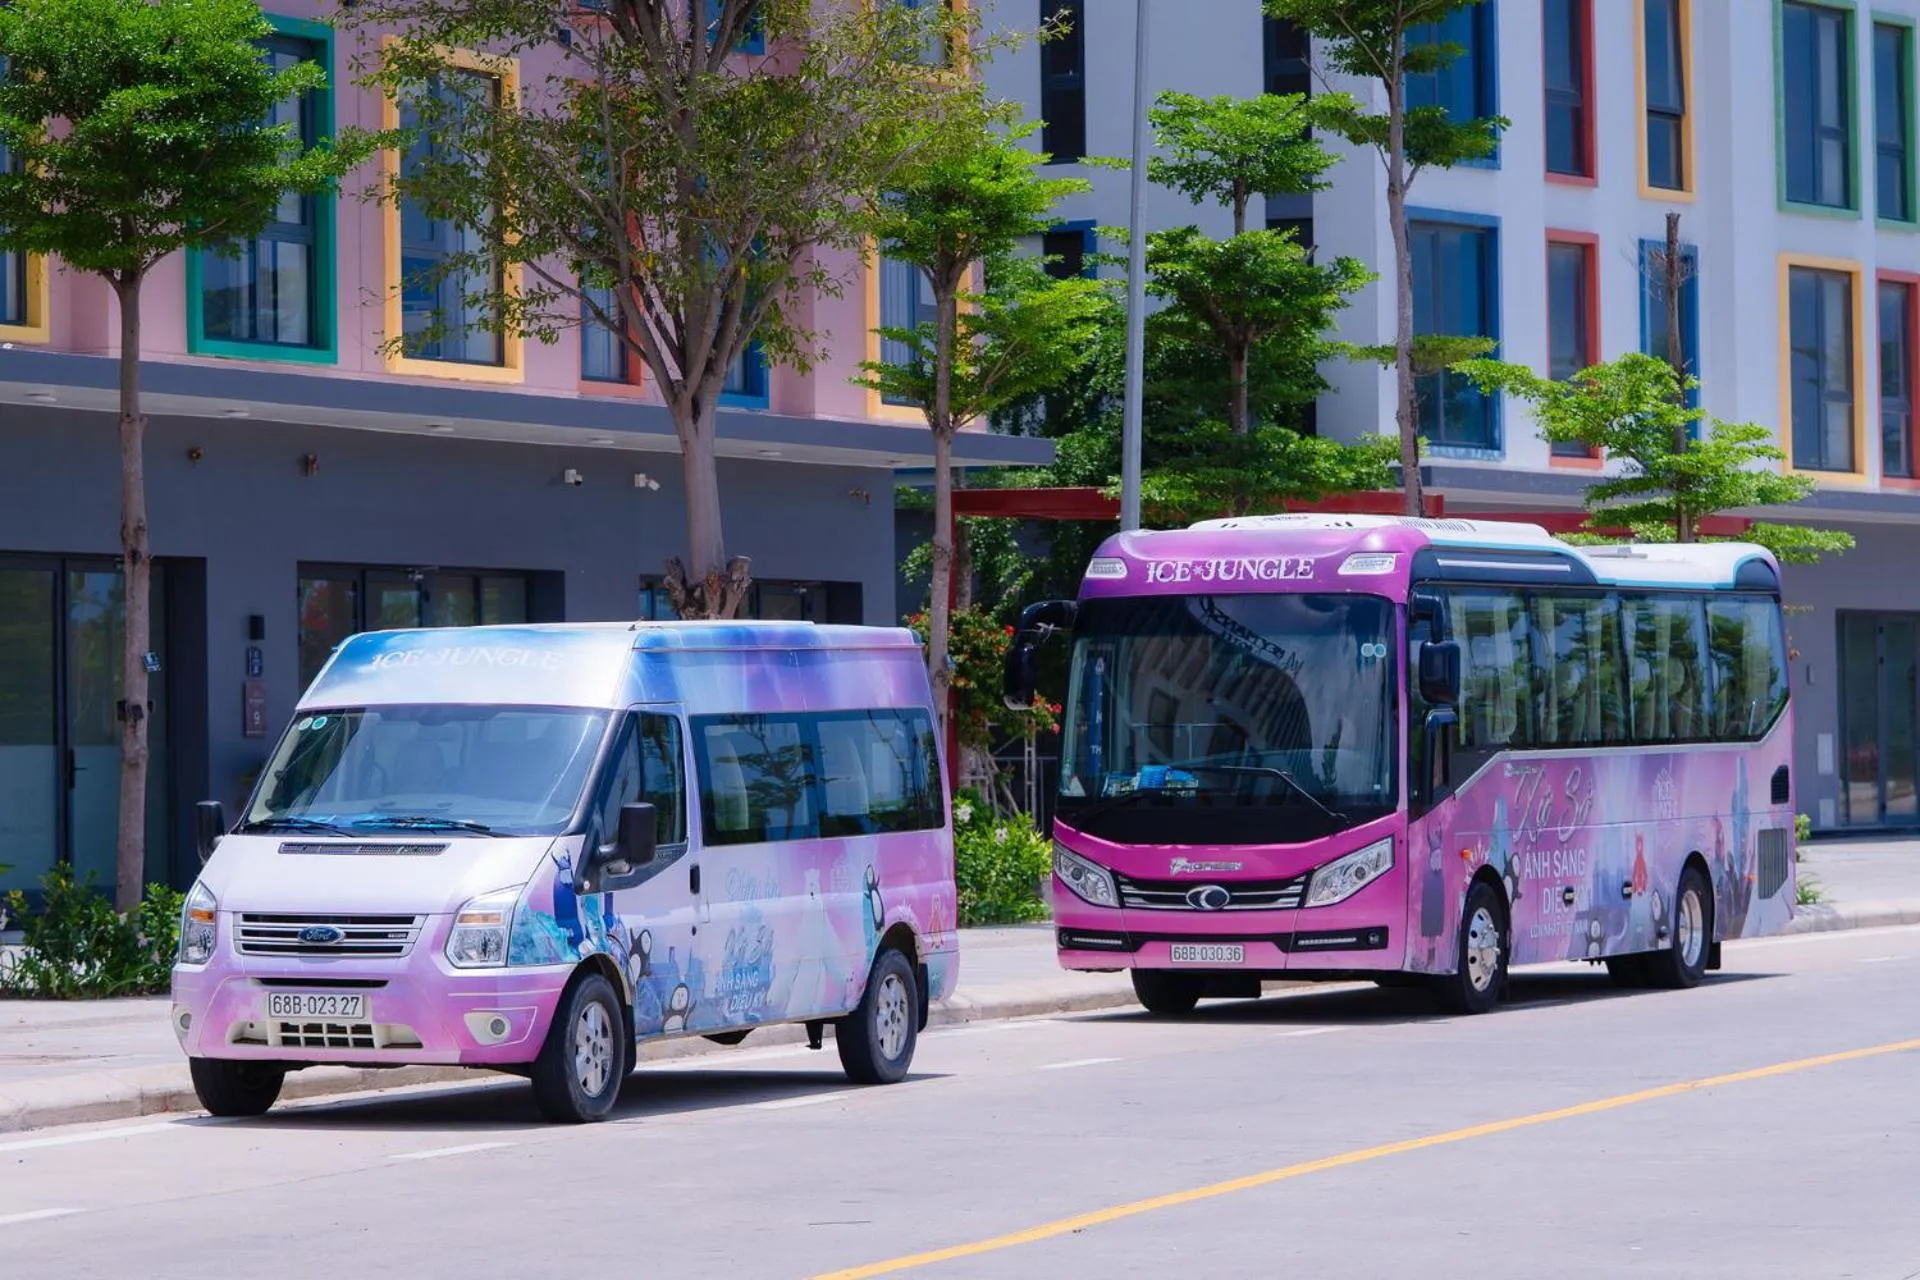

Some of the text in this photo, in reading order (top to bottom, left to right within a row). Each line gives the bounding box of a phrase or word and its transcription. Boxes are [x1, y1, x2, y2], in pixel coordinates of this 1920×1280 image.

[1146, 557, 1315, 583] ICE JUNGLE
[370, 645, 564, 671] ICE JUNGLE
[1523, 845, 1551, 879] ÁNH
